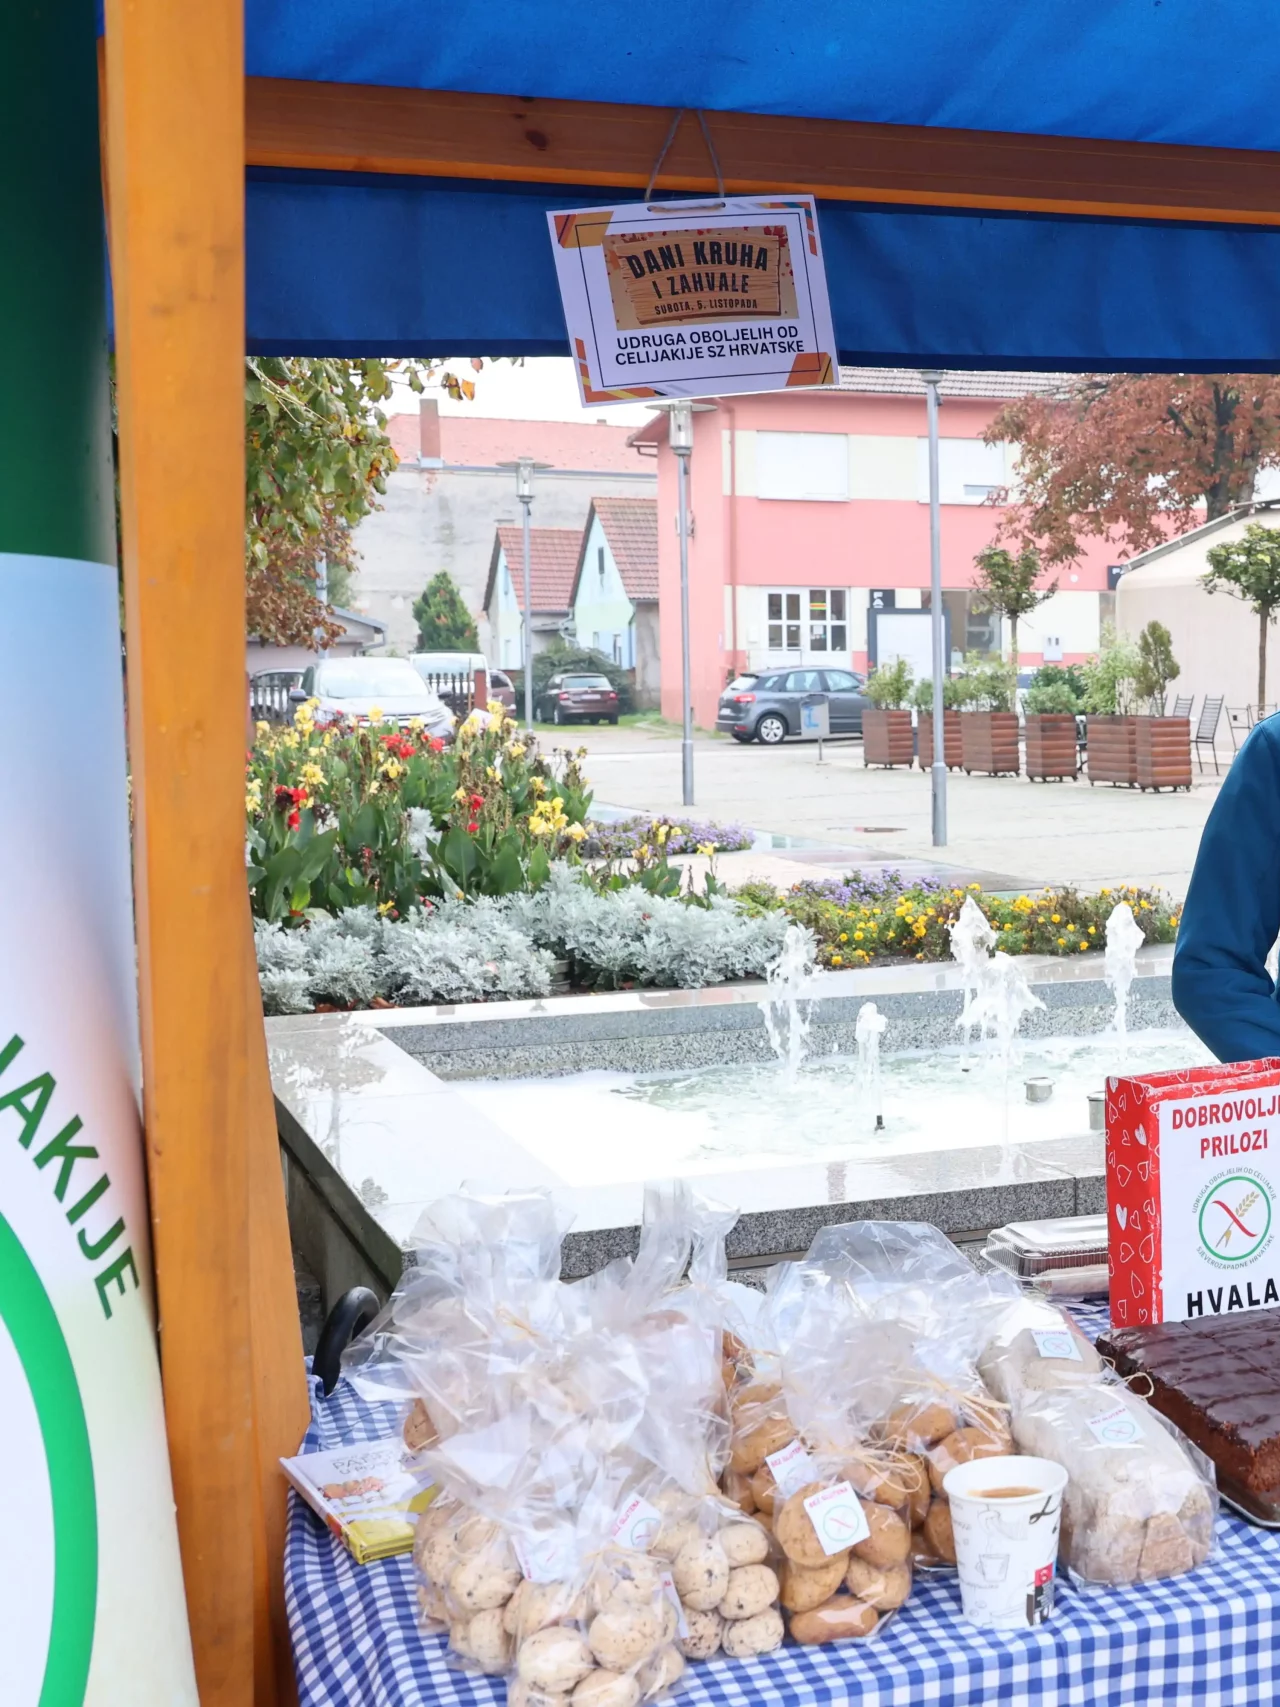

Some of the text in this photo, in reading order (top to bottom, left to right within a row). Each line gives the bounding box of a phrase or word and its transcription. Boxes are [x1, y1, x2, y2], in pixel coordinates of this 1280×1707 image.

[626, 241, 768, 279] DANI KRUHA
[651, 272, 749, 299] I ZAHVALE
[709, 298, 758, 310] LISTOPADA
[616, 325, 799, 349] UDRUGA OBOLJELIH OD
[615, 340, 805, 365] CELIJAKIJE SZ HRVATSKE
[1200, 1129, 1268, 1159] PRILOZI
[1191, 1184, 1210, 1214] UDRUGA
[1208, 1166, 1243, 1185] OBOLJELIH
[1243, 1167, 1254, 1175] OD
[1196, 1235, 1275, 1270] SJEVEROZAPADNE HRVATSKE
